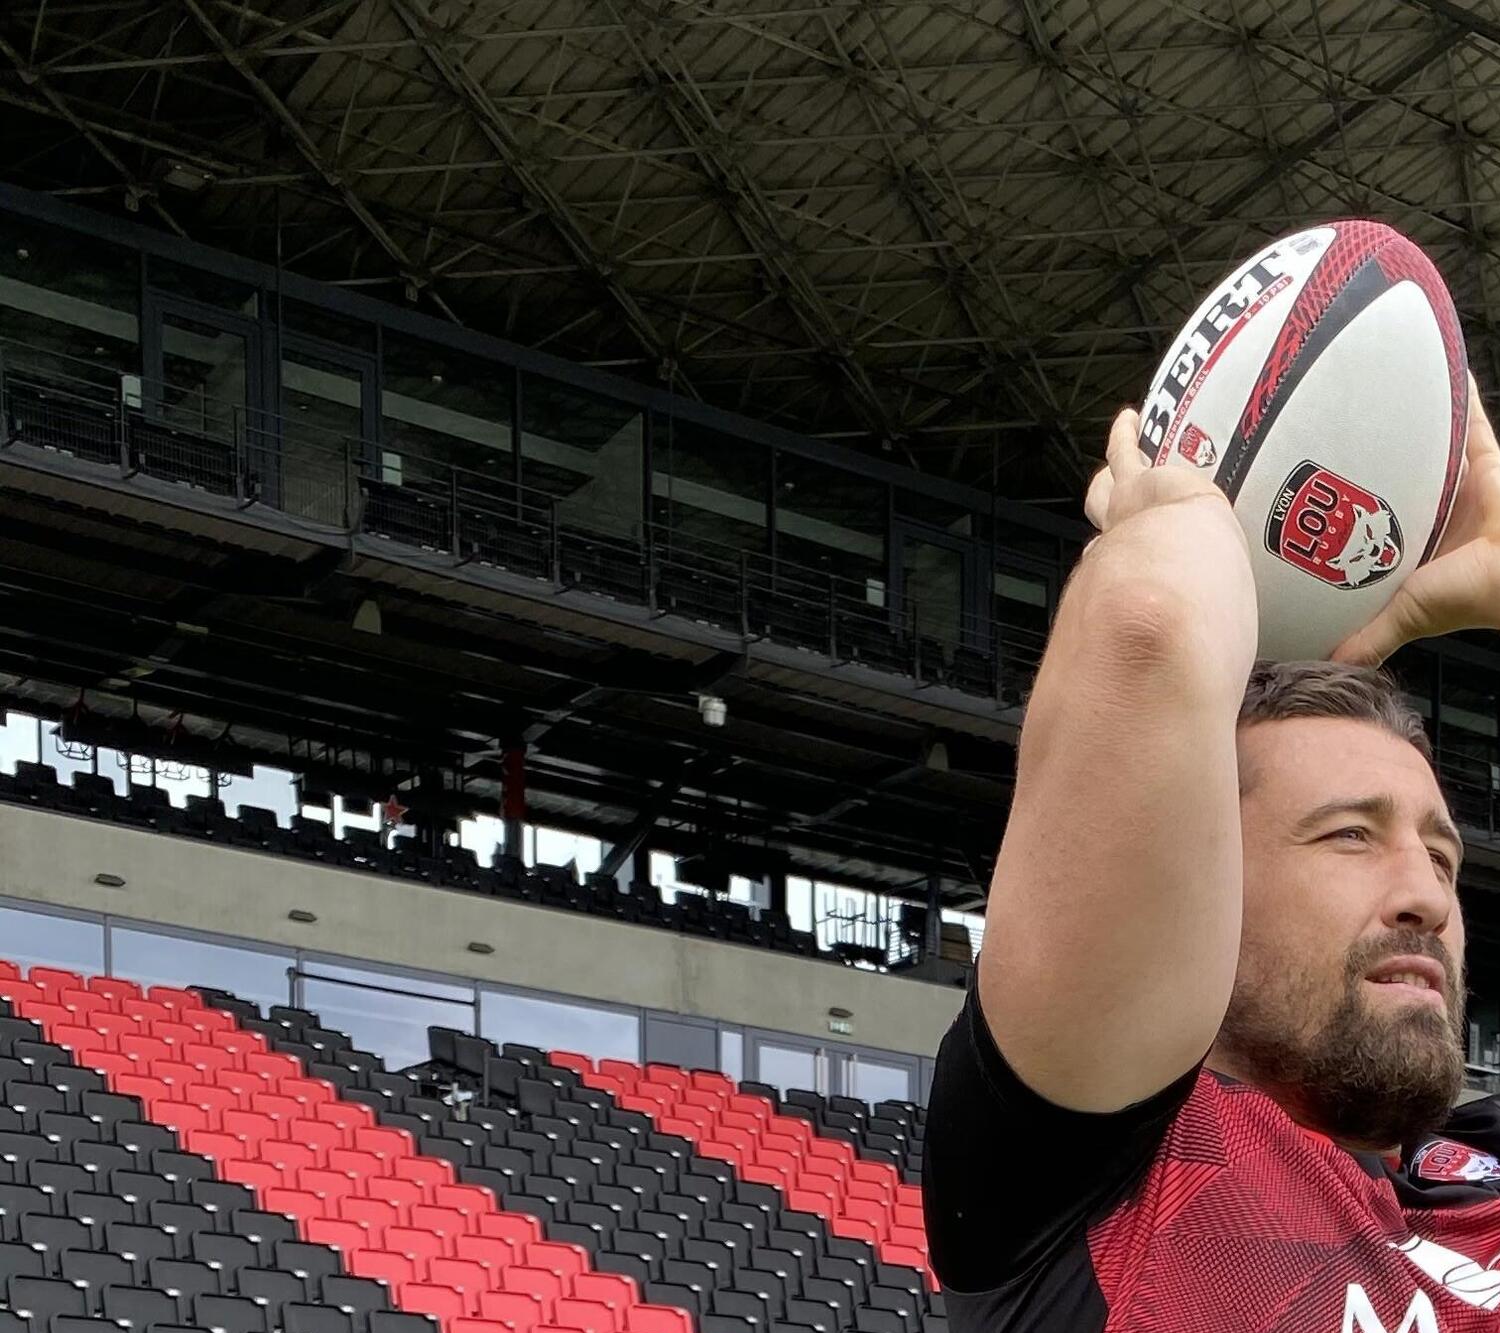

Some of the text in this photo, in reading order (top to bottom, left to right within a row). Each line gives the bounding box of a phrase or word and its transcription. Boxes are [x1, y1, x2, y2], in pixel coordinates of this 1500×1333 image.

[1138, 250, 1284, 468] BERT
[1273, 487, 1295, 521] LYON
[1283, 477, 1340, 560] LOU
[1312, 493, 1351, 566] RUGBY
[1421, 1144, 1458, 1174] LOU
